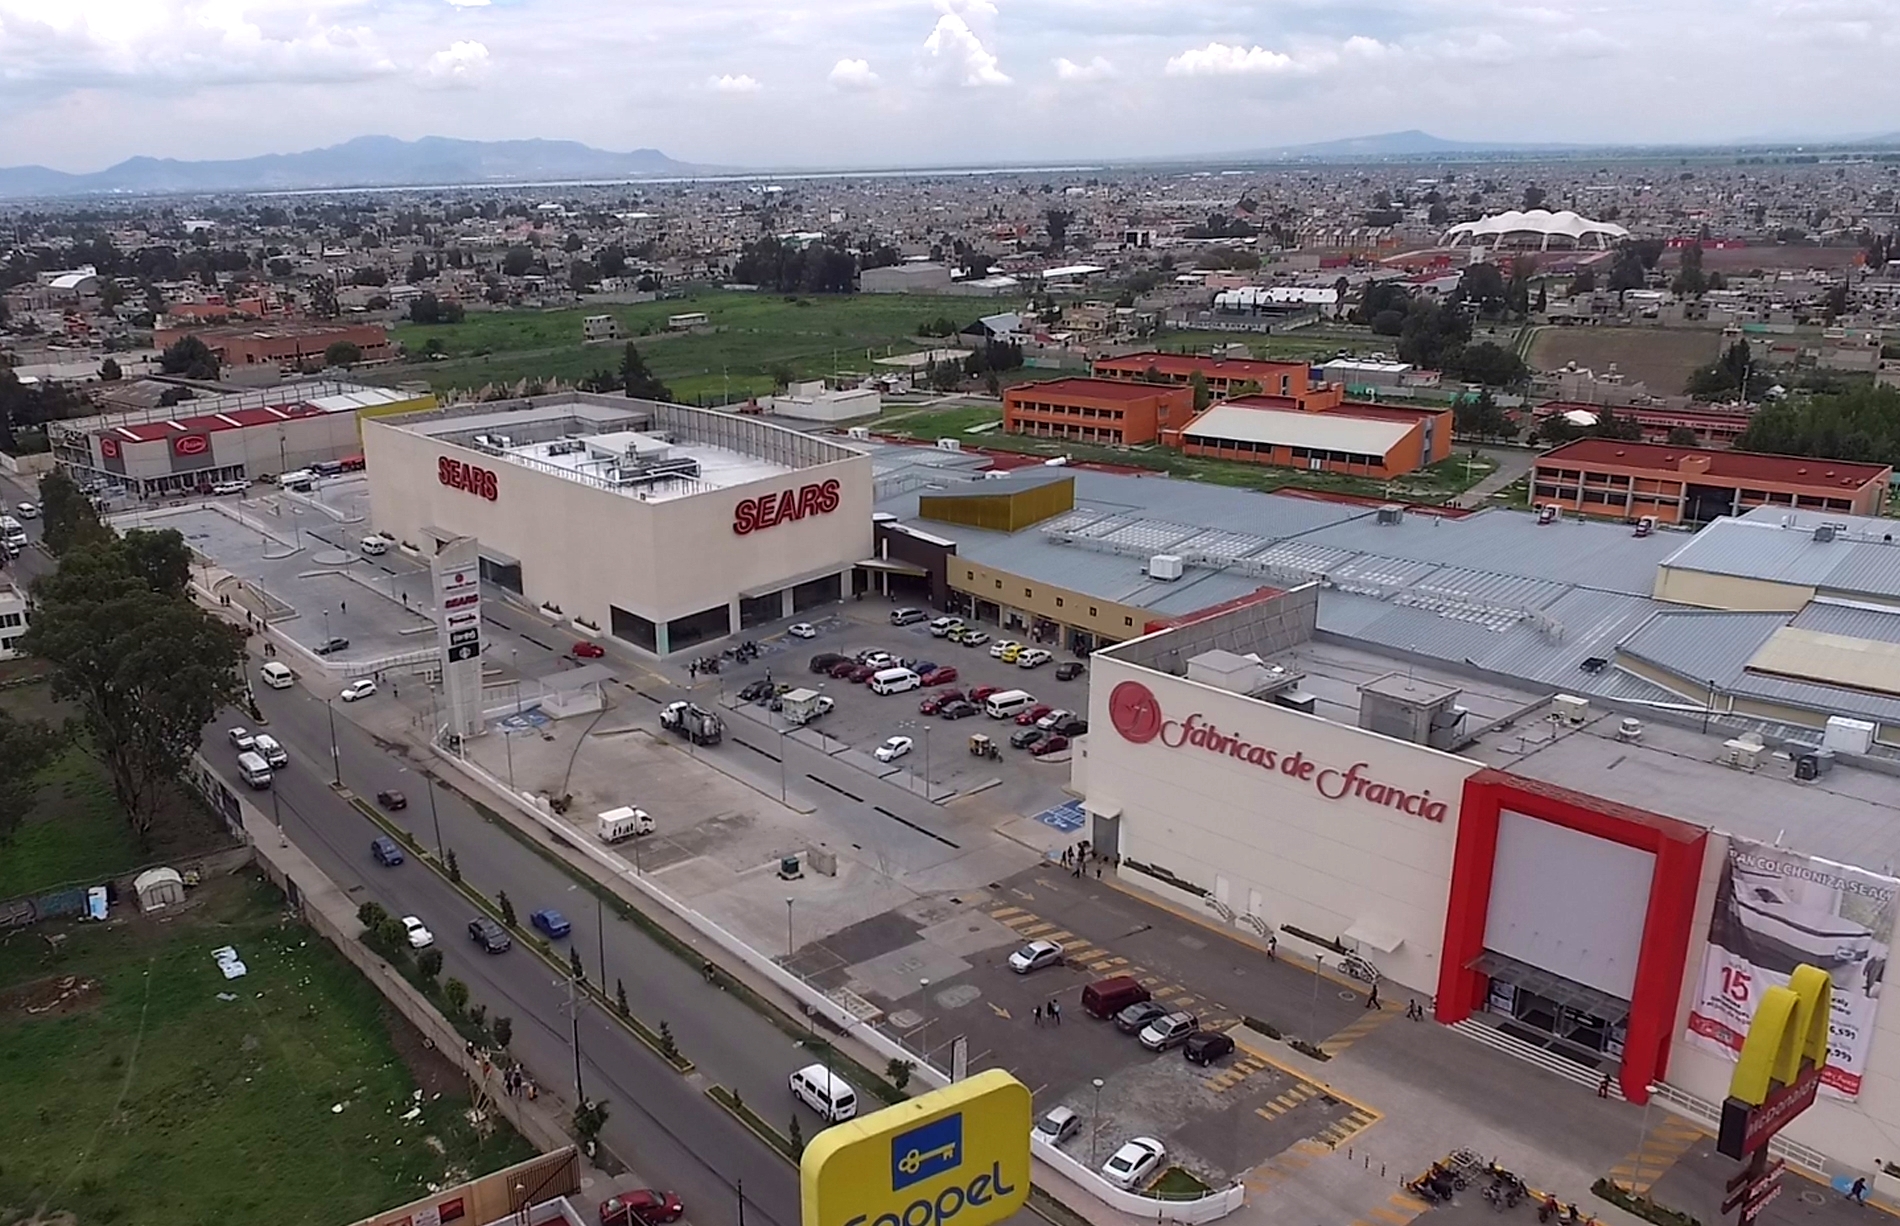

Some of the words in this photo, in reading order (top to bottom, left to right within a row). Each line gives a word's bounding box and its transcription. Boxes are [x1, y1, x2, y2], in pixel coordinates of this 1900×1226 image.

[438, 456, 498, 501] SEARS
[733, 479, 840, 535] SEARS
[1280, 751, 1315, 781] de
[1757, 858, 1847, 891] COLCHONIZA
[1722, 966, 1752, 1001] 15
